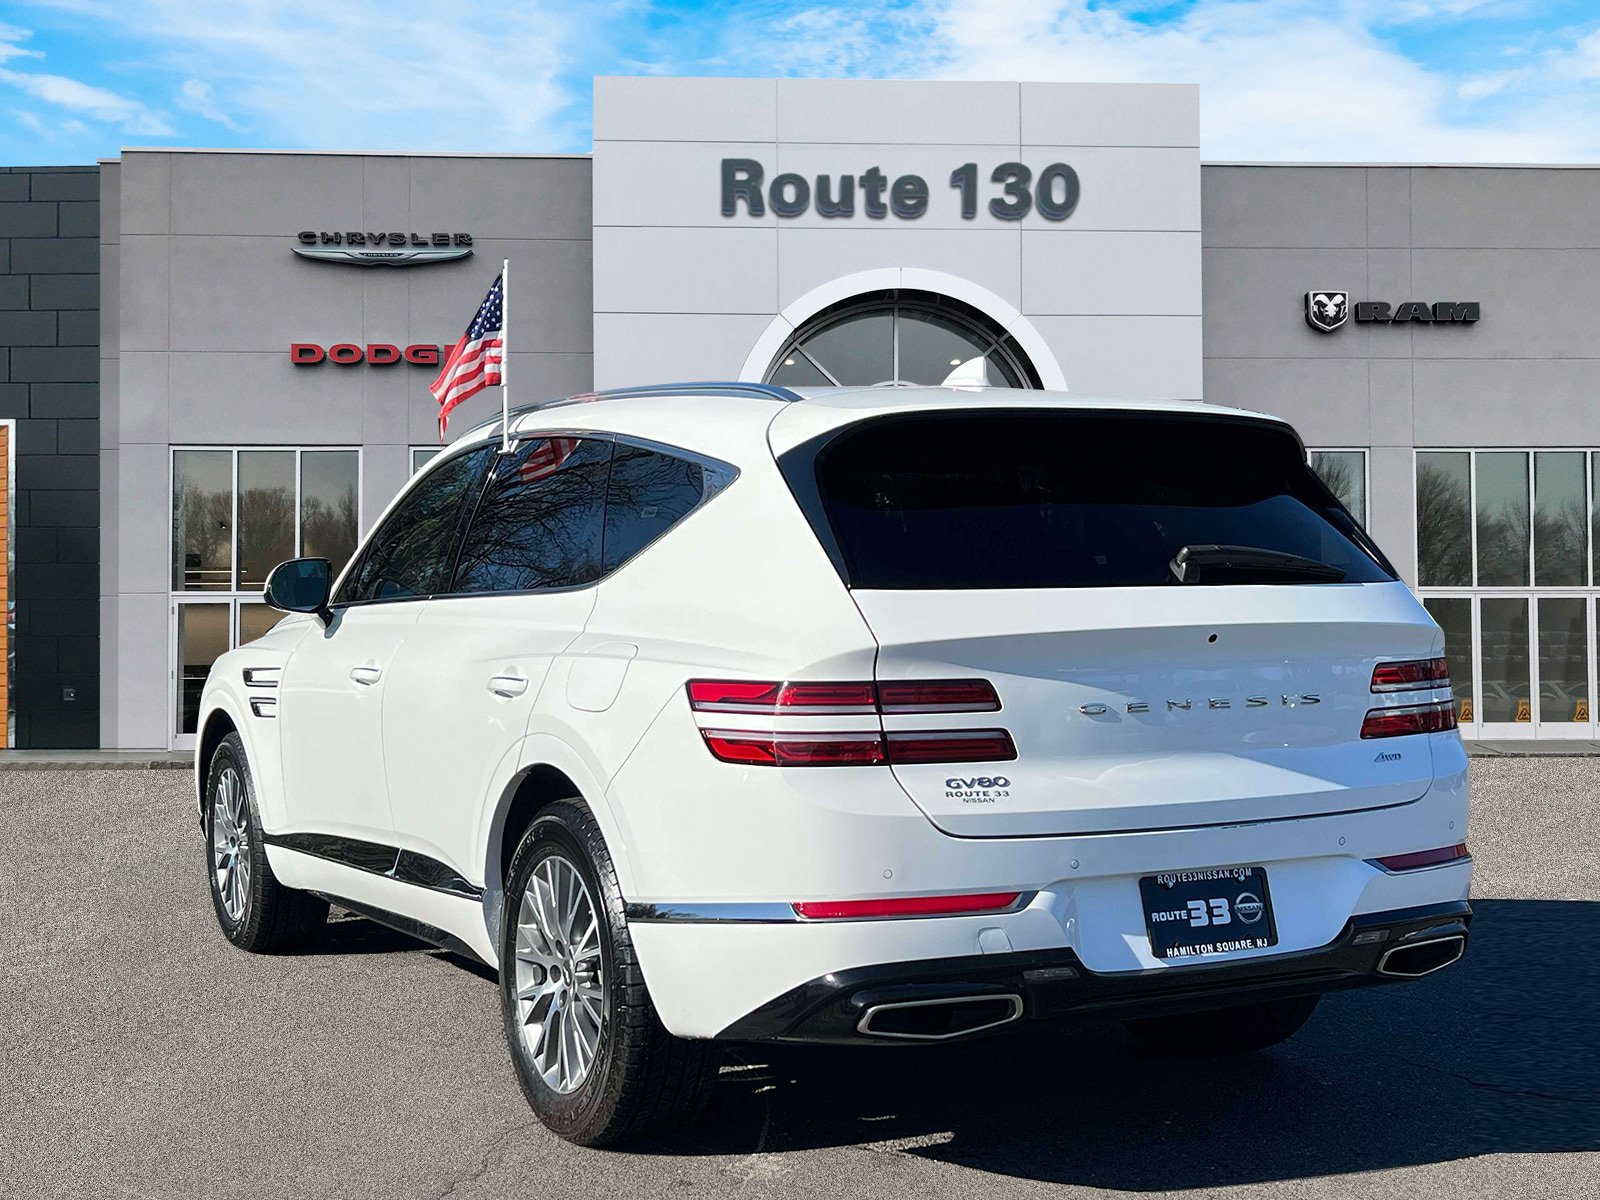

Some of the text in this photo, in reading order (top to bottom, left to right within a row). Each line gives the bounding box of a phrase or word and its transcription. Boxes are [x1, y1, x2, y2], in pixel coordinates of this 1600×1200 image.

[721, 158, 1080, 221] Route 130
[298, 231, 473, 246] CHRYSLER
[1355, 302, 1480, 324] RAM
[1079, 694, 1321, 715] GENESIS
[945, 776, 1011, 789] GV80
[1157, 867, 1252, 885] ROUTE33NISSAN.COM
[1151, 897, 1232, 928] ROUTE 33
[1166, 943, 1214, 958] HAMILTON
[1257, 938, 1269, 948] NJ
